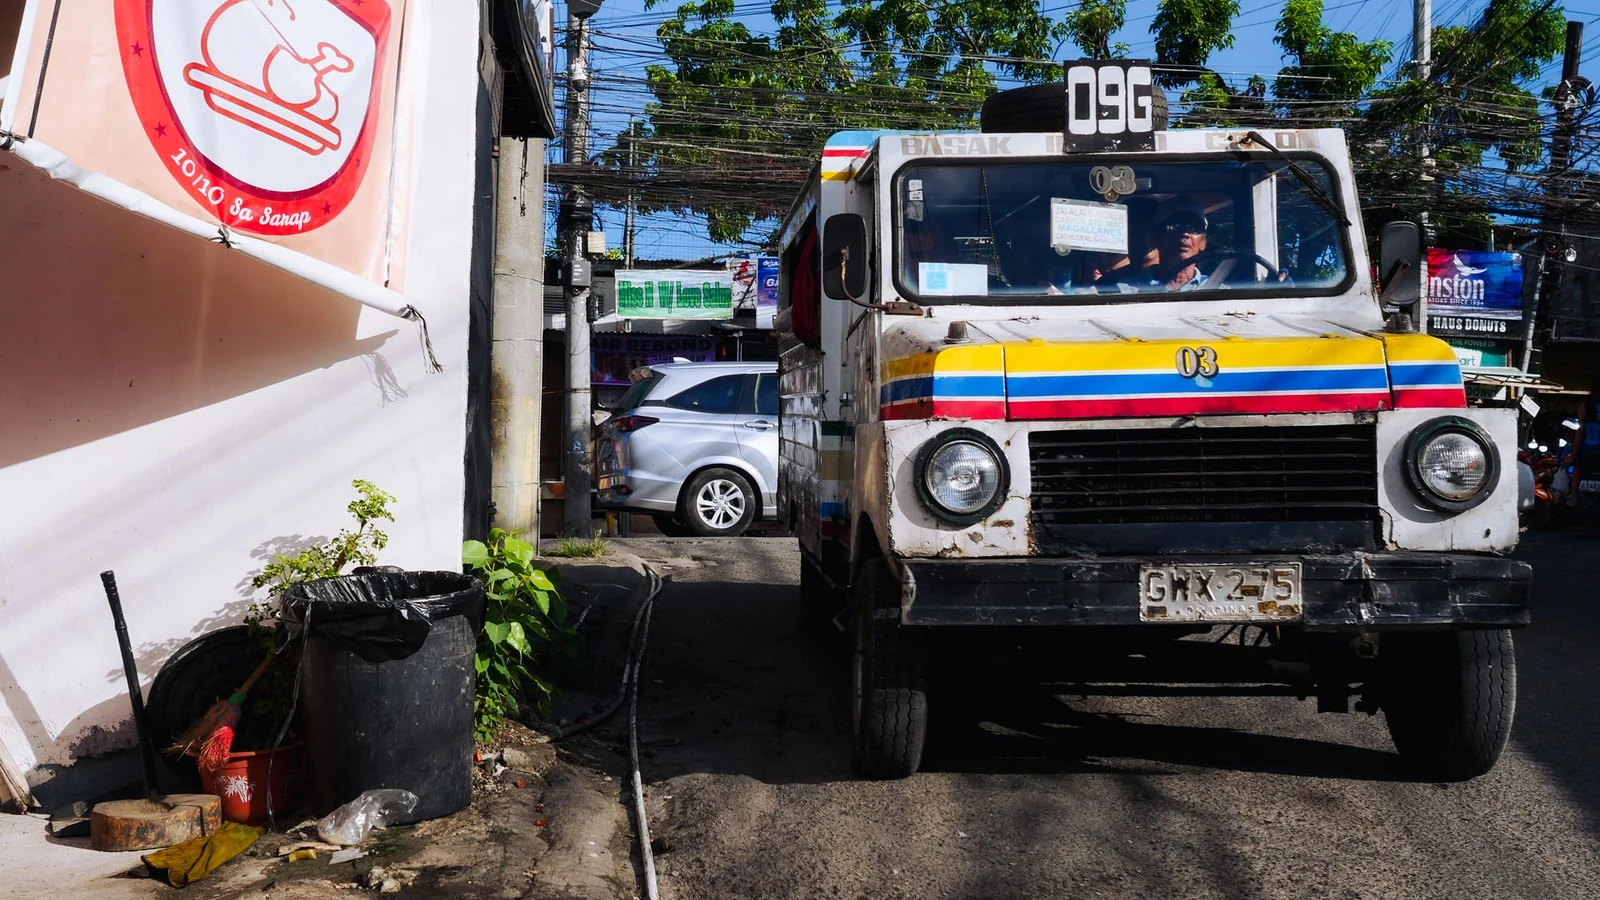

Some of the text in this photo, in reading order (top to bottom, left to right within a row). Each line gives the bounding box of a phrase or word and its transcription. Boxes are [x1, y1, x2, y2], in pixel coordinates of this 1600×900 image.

[1068, 66, 1152, 134] 09G
[901, 136, 1012, 155] BASAK
[171, 148, 311, 230] 10/10 Sa Sarap
[1089, 166, 1136, 195] 03
[1055, 233, 1092, 242] CATHEDRAL
[1058, 224, 1122, 237] MAGALLANES
[677, 281, 701, 308] Love
[1427, 274, 1485, 300] nston
[1433, 317, 1507, 333] HAUS DONUTS
[628, 338, 711, 351] REBOND
[1175, 346, 1219, 379] 03
[1458, 355, 1476, 367] art
[1147, 569, 1216, 602] GWX
